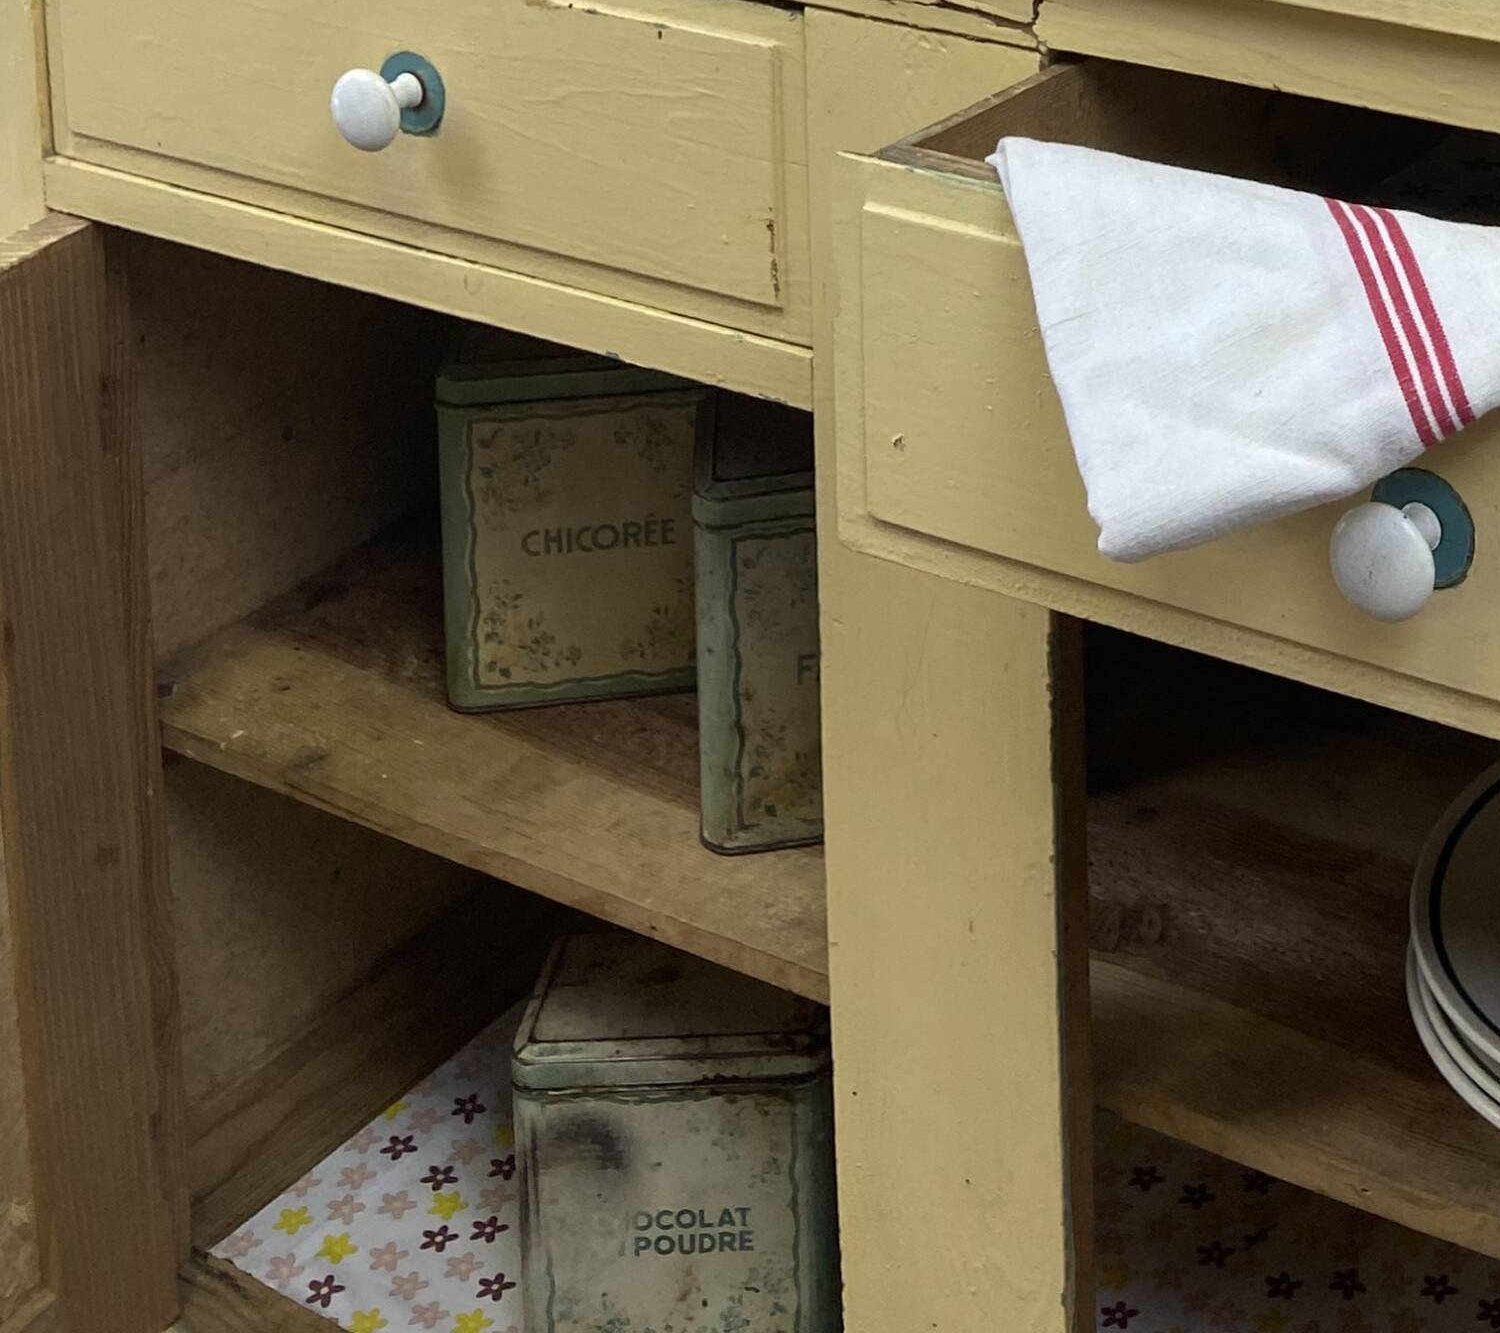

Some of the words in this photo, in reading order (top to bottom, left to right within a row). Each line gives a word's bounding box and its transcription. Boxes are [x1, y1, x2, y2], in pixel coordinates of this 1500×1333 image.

[797, 653, 818, 686] F
[626, 1206, 752, 1232] OCOLAT
[633, 1230, 755, 1257] POUDRE
